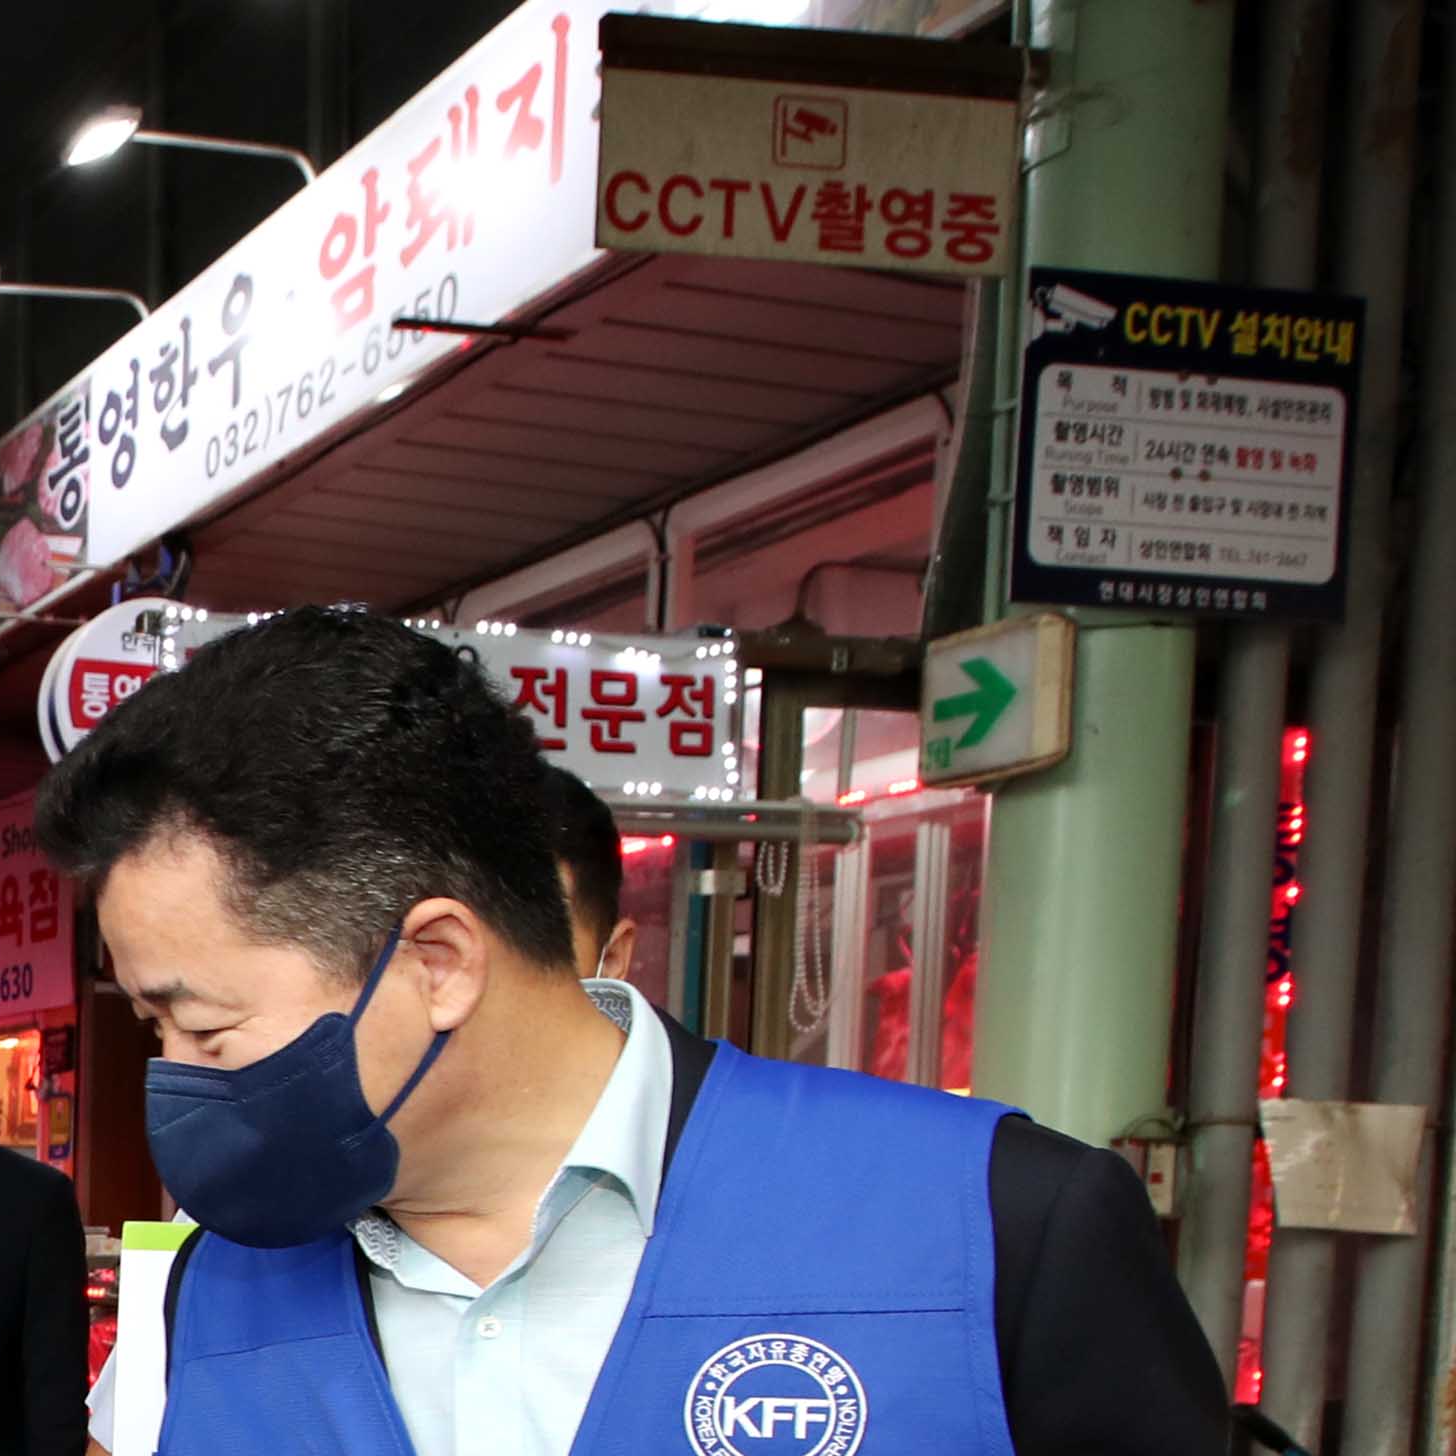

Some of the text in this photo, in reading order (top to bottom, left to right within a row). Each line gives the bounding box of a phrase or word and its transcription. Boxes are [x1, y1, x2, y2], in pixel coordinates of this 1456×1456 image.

[603, 170, 1002, 266] CCTV촬영중
[1124, 302, 1355, 365] CCTV 설치안내
[47, 272, 255, 530] 통영한우
[1053, 420, 1125, 446] 촬영시간
[510, 667, 717, 757] 전문점
[709, 1341, 848, 1387] 한국자유총연맹
[721, 1396, 831, 1439] KFF
